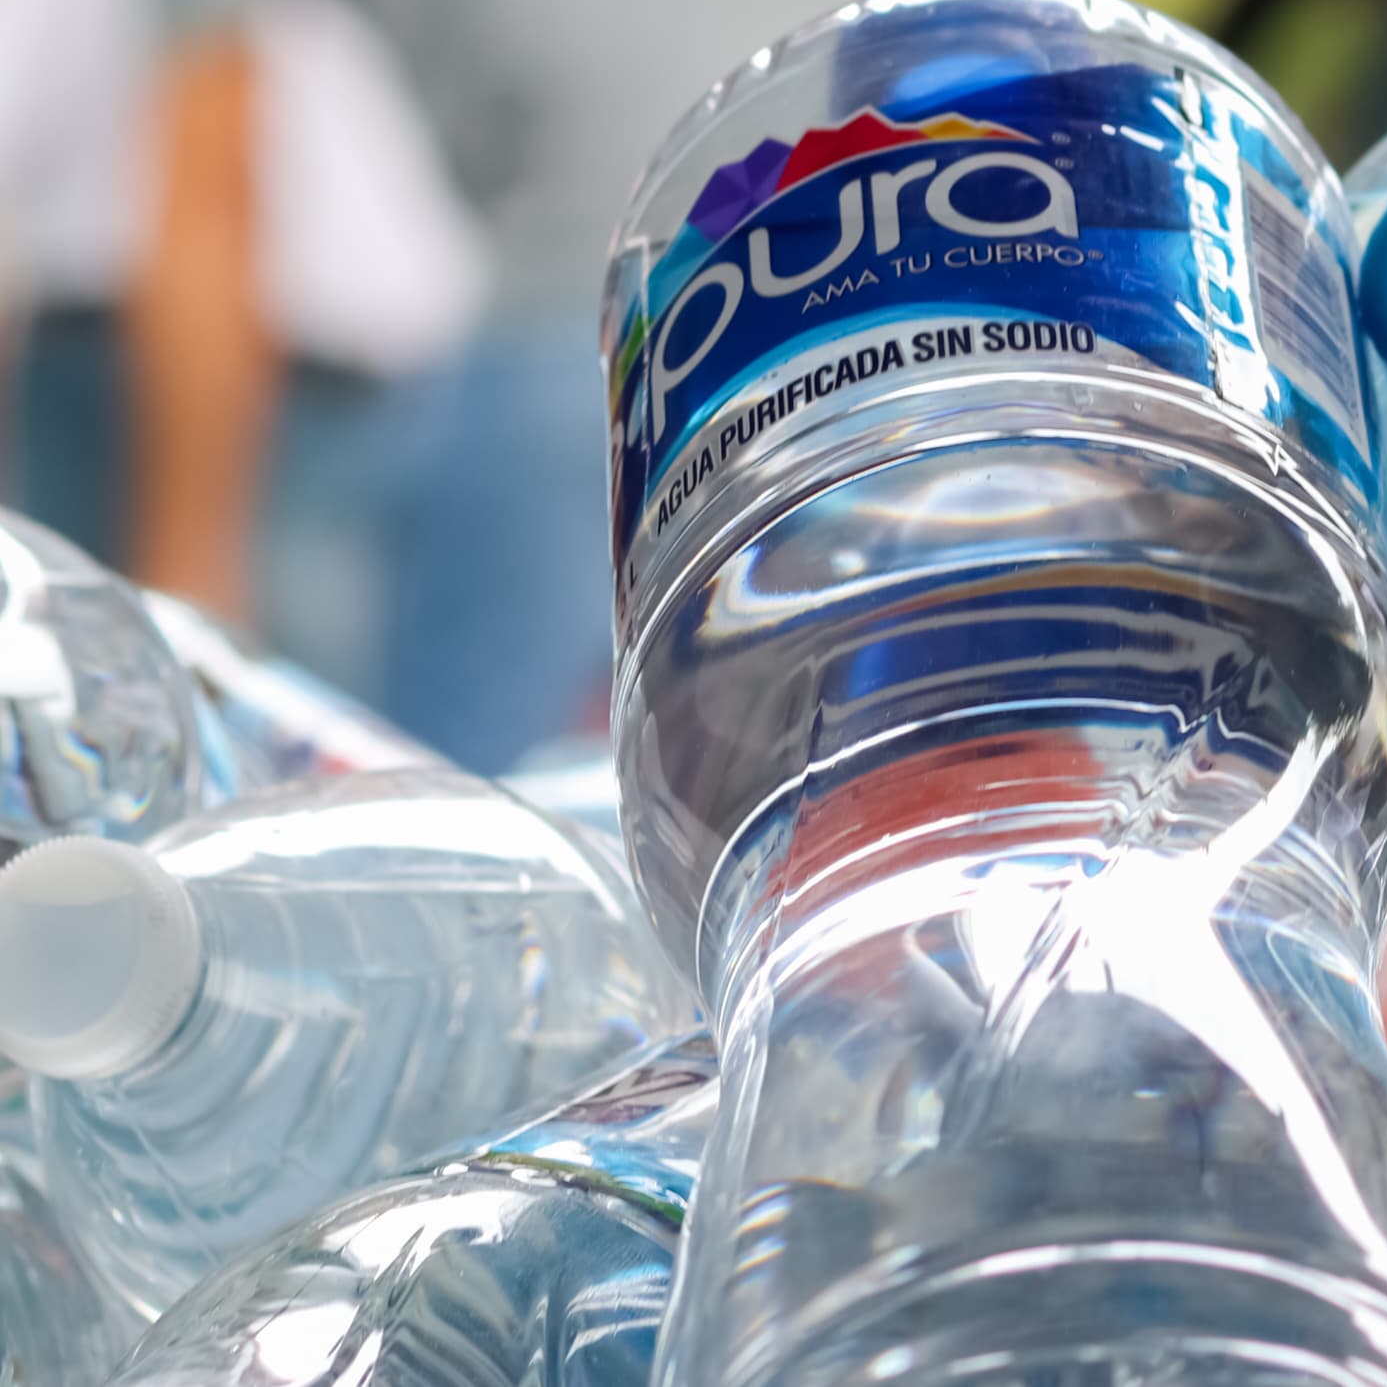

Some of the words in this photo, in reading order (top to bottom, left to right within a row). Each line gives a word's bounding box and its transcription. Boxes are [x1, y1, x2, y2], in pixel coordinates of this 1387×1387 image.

[801, 269, 880, 314] AMA
[890, 252, 932, 278] TU
[656, 446, 714, 537] AGUA
[720, 340, 904, 462] PURIFICADA
[912, 325, 973, 363] SIN
[982, 320, 1097, 355] SODIO
